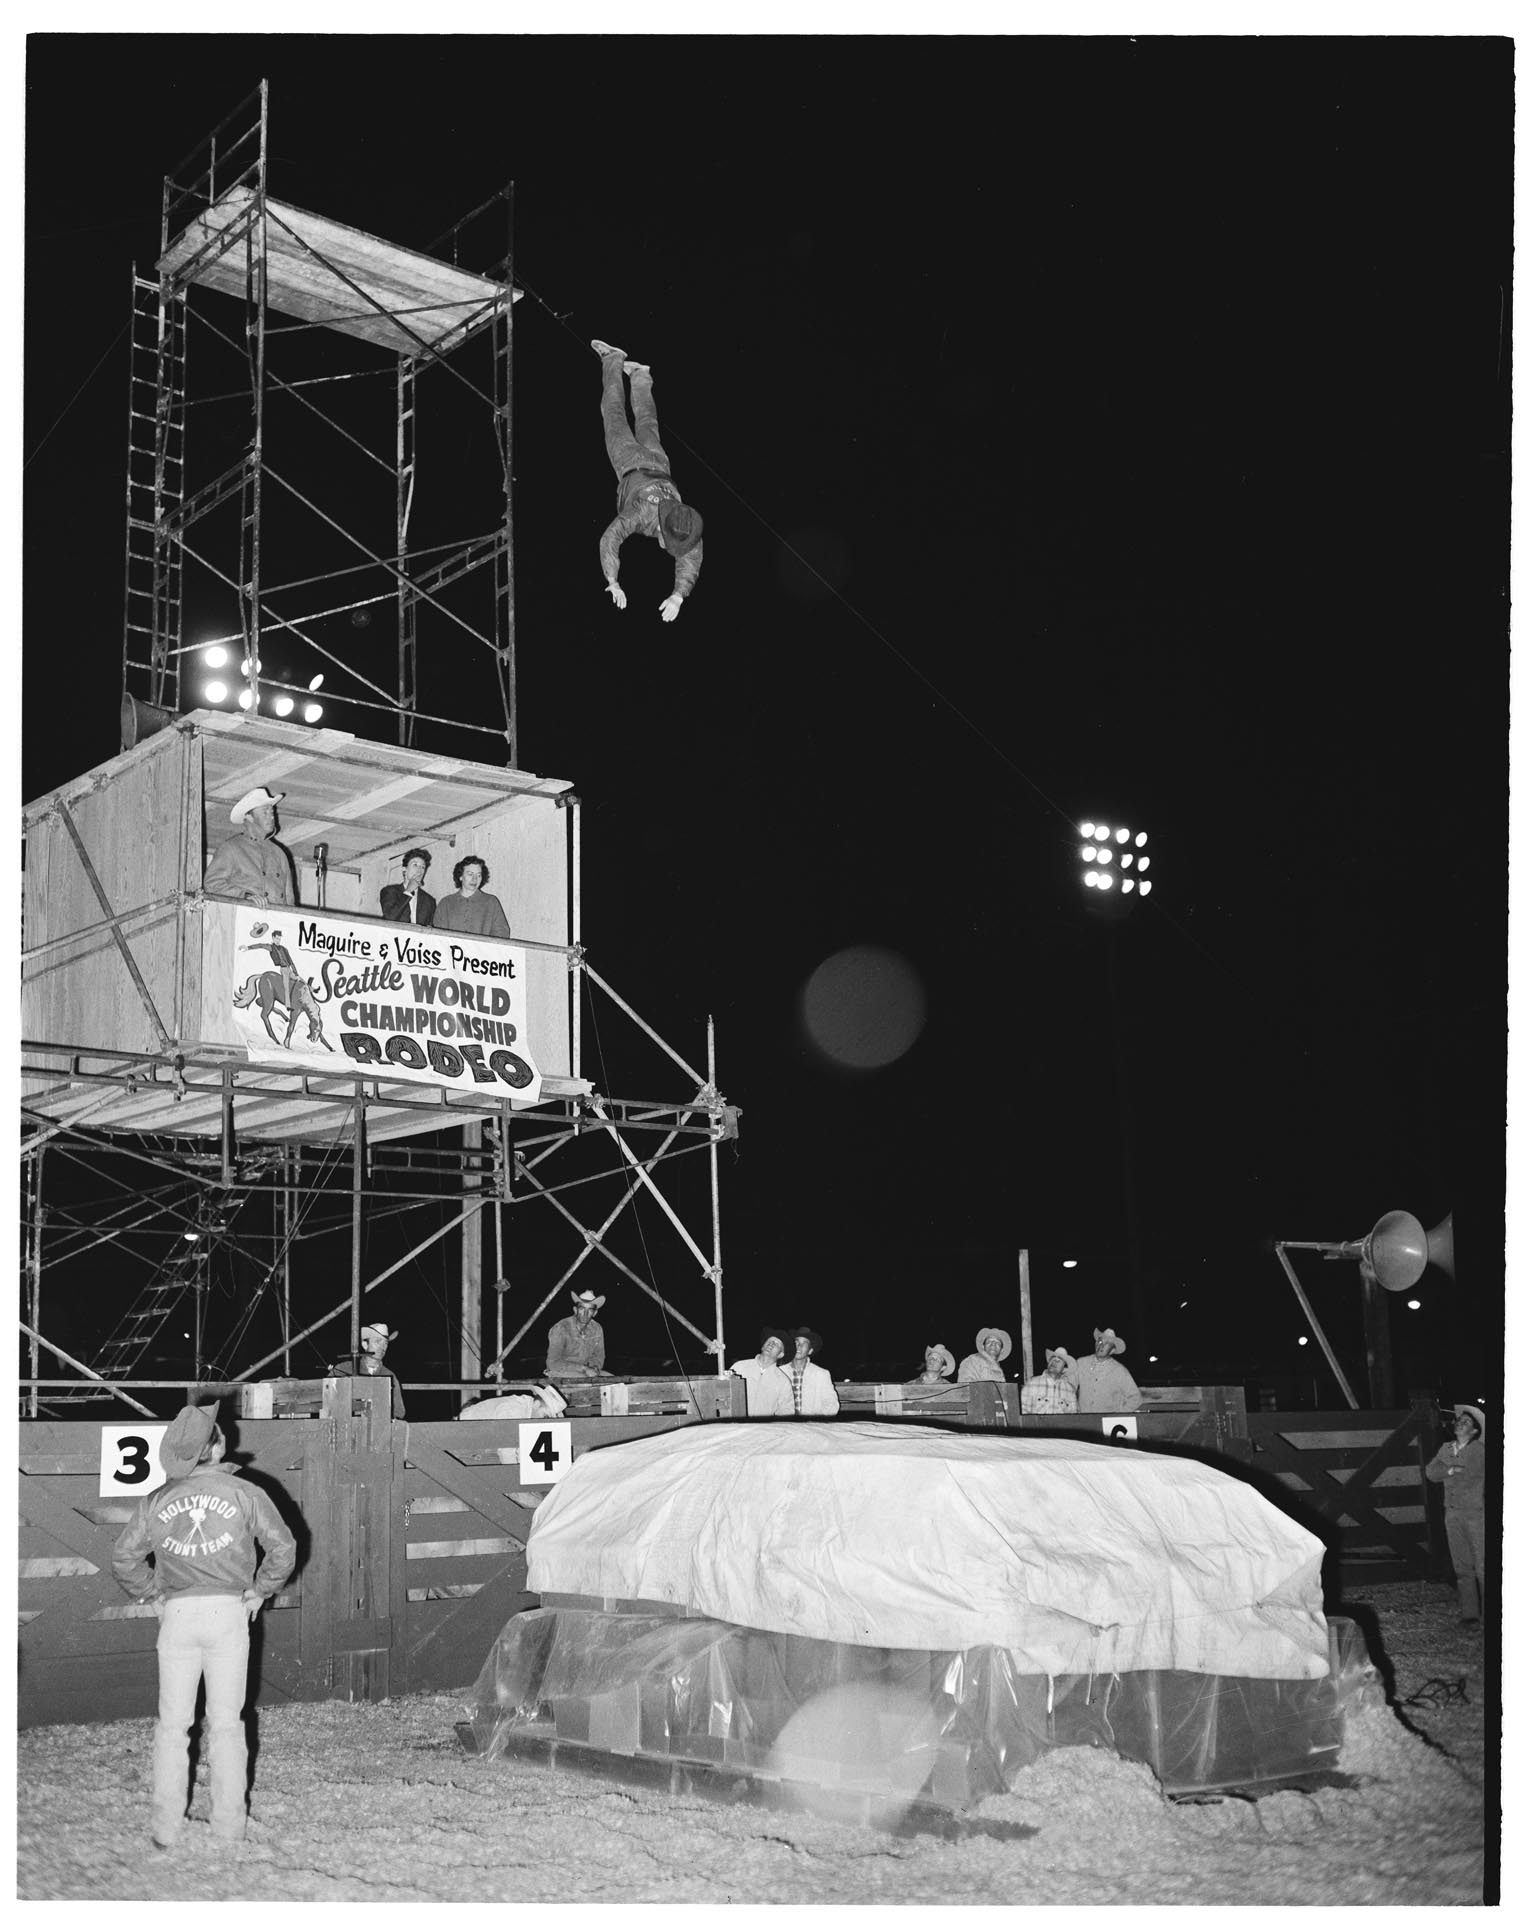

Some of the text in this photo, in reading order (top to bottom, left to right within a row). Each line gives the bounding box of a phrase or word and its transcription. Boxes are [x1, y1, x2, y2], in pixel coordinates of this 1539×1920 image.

[298, 921, 516, 979] Maguire & Voiss Present
[307, 959, 511, 1016] Seattle WORLD
[340, 1000, 517, 1046] CHAMPIONSHIP
[340, 1033, 534, 1089] RODEO
[113, 1436, 151, 1484] 3
[529, 1431, 559, 1471] 4
[158, 1495, 237, 1524] HOLLYWOOD
[161, 1532, 234, 1557] STUNT TEAM
